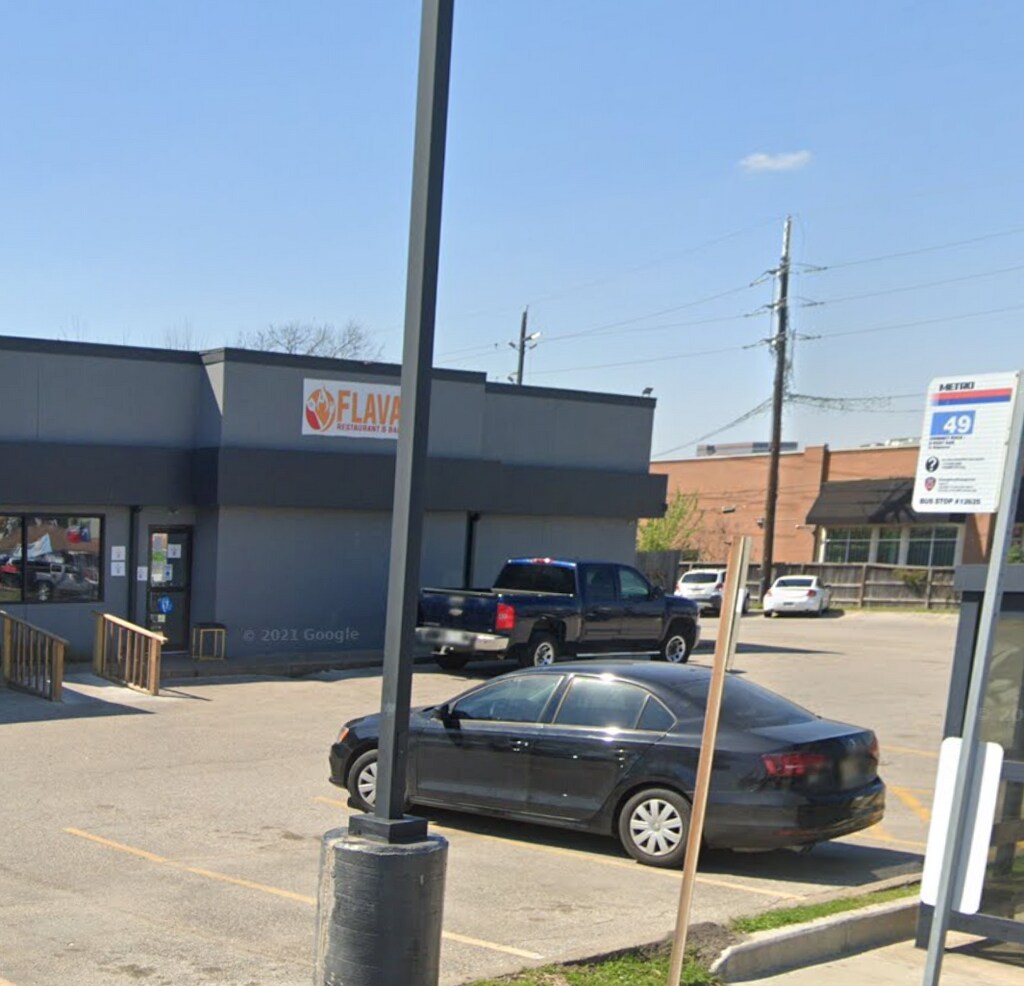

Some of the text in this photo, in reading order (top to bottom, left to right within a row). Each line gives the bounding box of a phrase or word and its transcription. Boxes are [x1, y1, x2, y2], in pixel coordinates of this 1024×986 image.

[939, 382, 975, 391] METRO
[337, 424, 380, 433] RESTAURANT
[943, 415, 972, 434] 49
[919, 497, 933, 505] BUS
[935, 497, 954, 505] STOP
